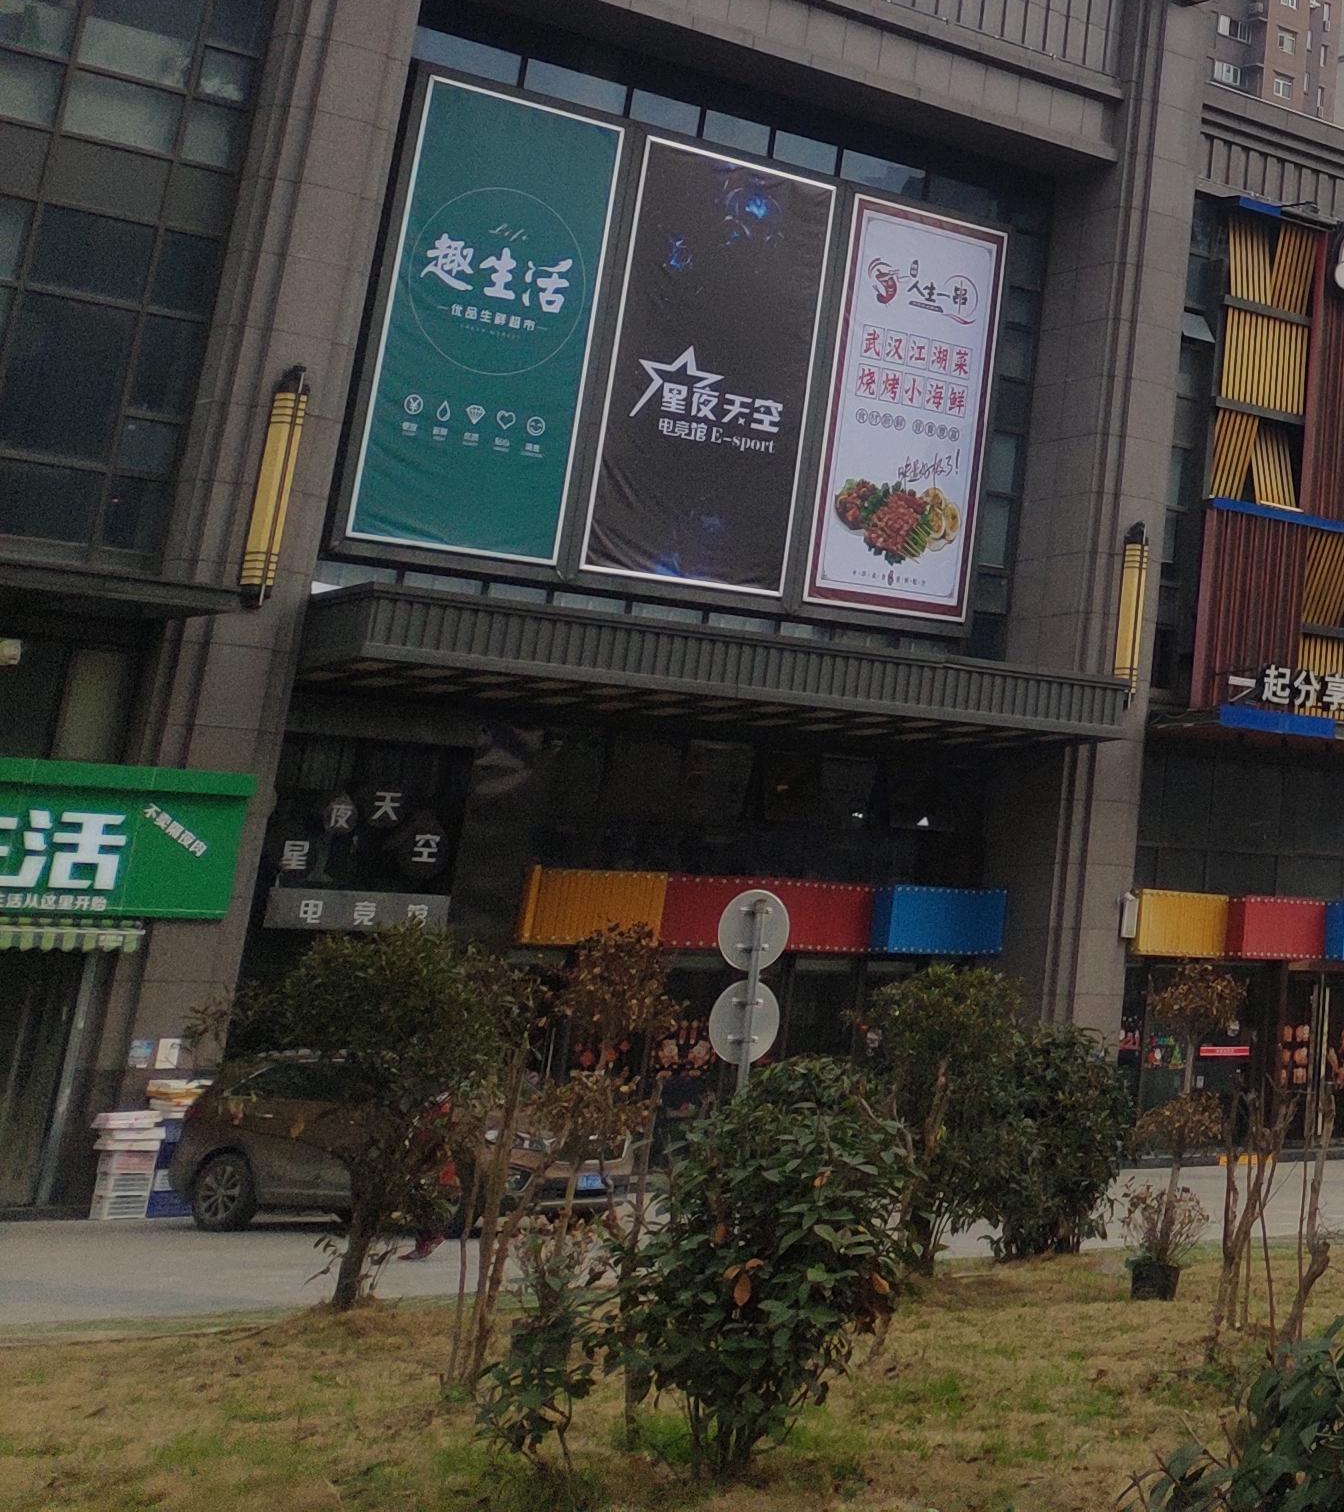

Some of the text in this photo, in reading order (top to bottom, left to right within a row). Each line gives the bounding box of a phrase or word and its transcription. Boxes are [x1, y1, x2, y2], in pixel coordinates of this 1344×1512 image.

[420, 233, 573, 314] 趣生活
[907, 280, 969, 308] 人生一串
[451, 303, 536, 331] 优品生鲜超市
[863, 330, 969, 376] 武汉江湖菜
[661, 382, 784, 434] 星夜天空
[858, 368, 965, 415] 烧烤小海鲜
[658, 418, 775, 454] 电竞馆 E-sport
[0, 809, 127, 890] 活
[281, 791, 441, 870] 星夜天空
[0, 892, 107, 912] 活从这里开始
